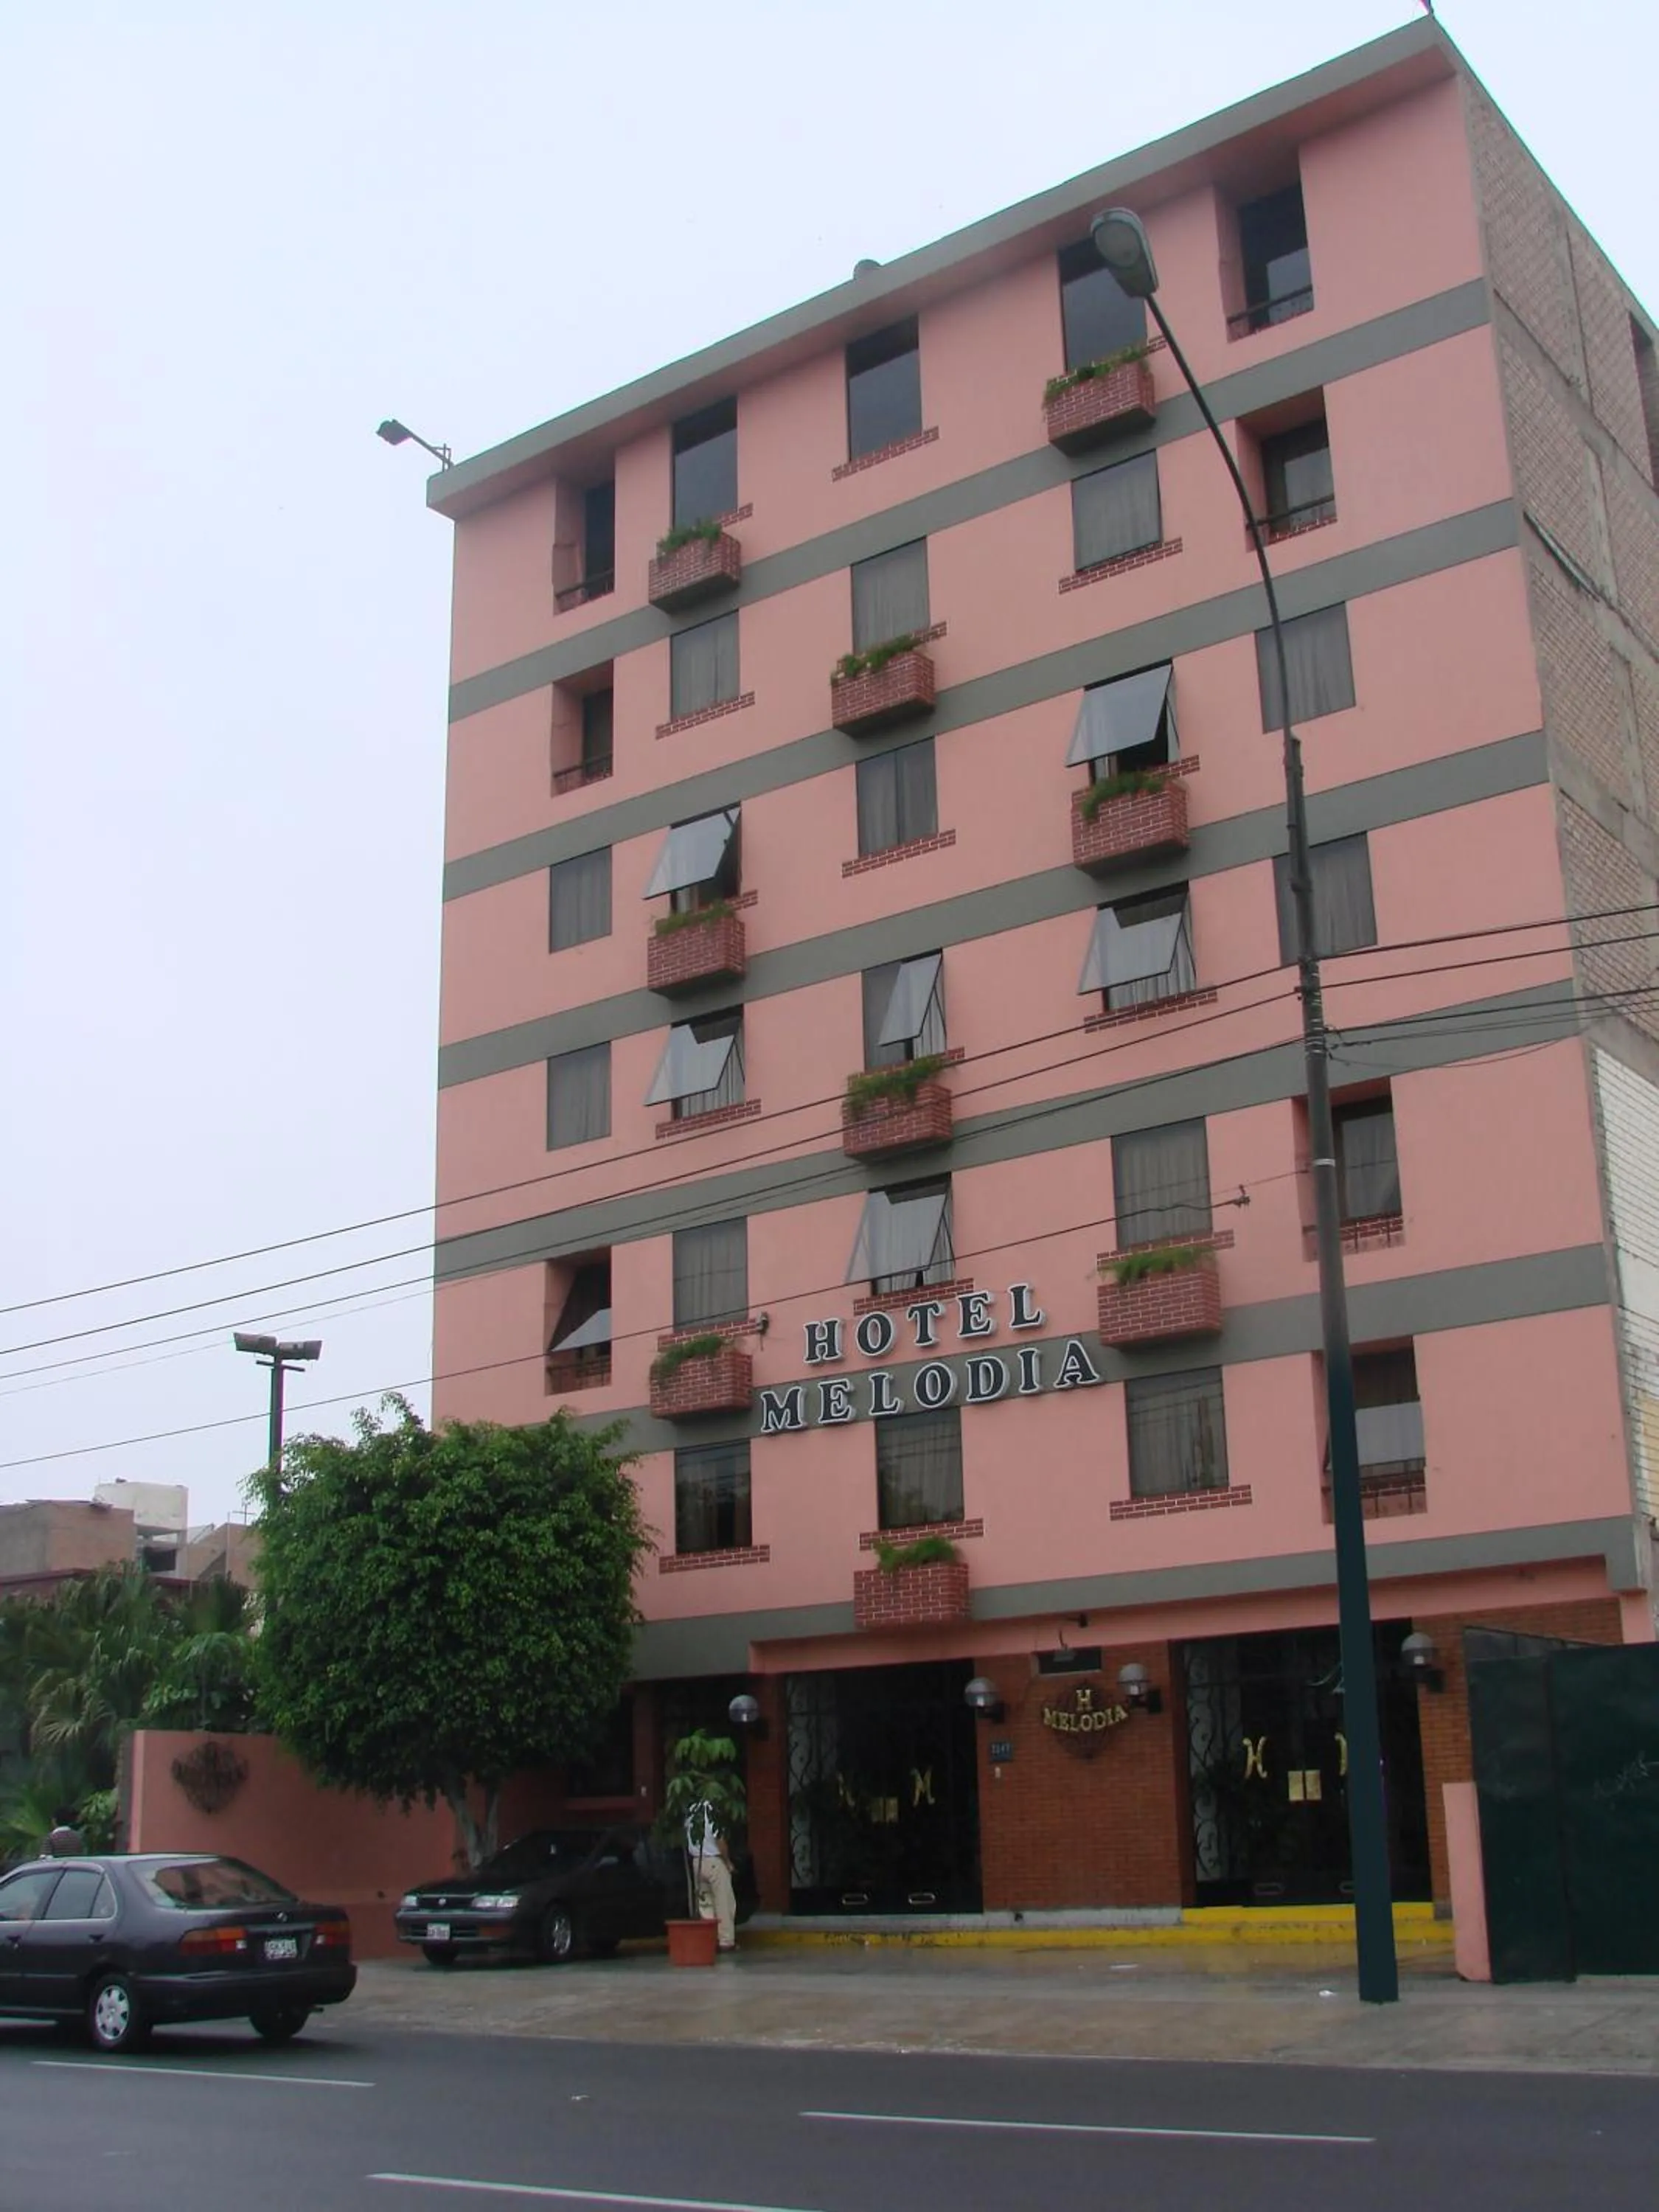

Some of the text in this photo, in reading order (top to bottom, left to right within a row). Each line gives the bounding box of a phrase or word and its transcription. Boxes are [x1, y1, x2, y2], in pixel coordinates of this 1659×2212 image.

[803, 1283, 1044, 1364] HOTEL
[760, 1338, 1100, 1433] MELODIA
[1043, 1704, 1128, 1733] MELODIA
[1075, 1688, 1093, 1711] H
